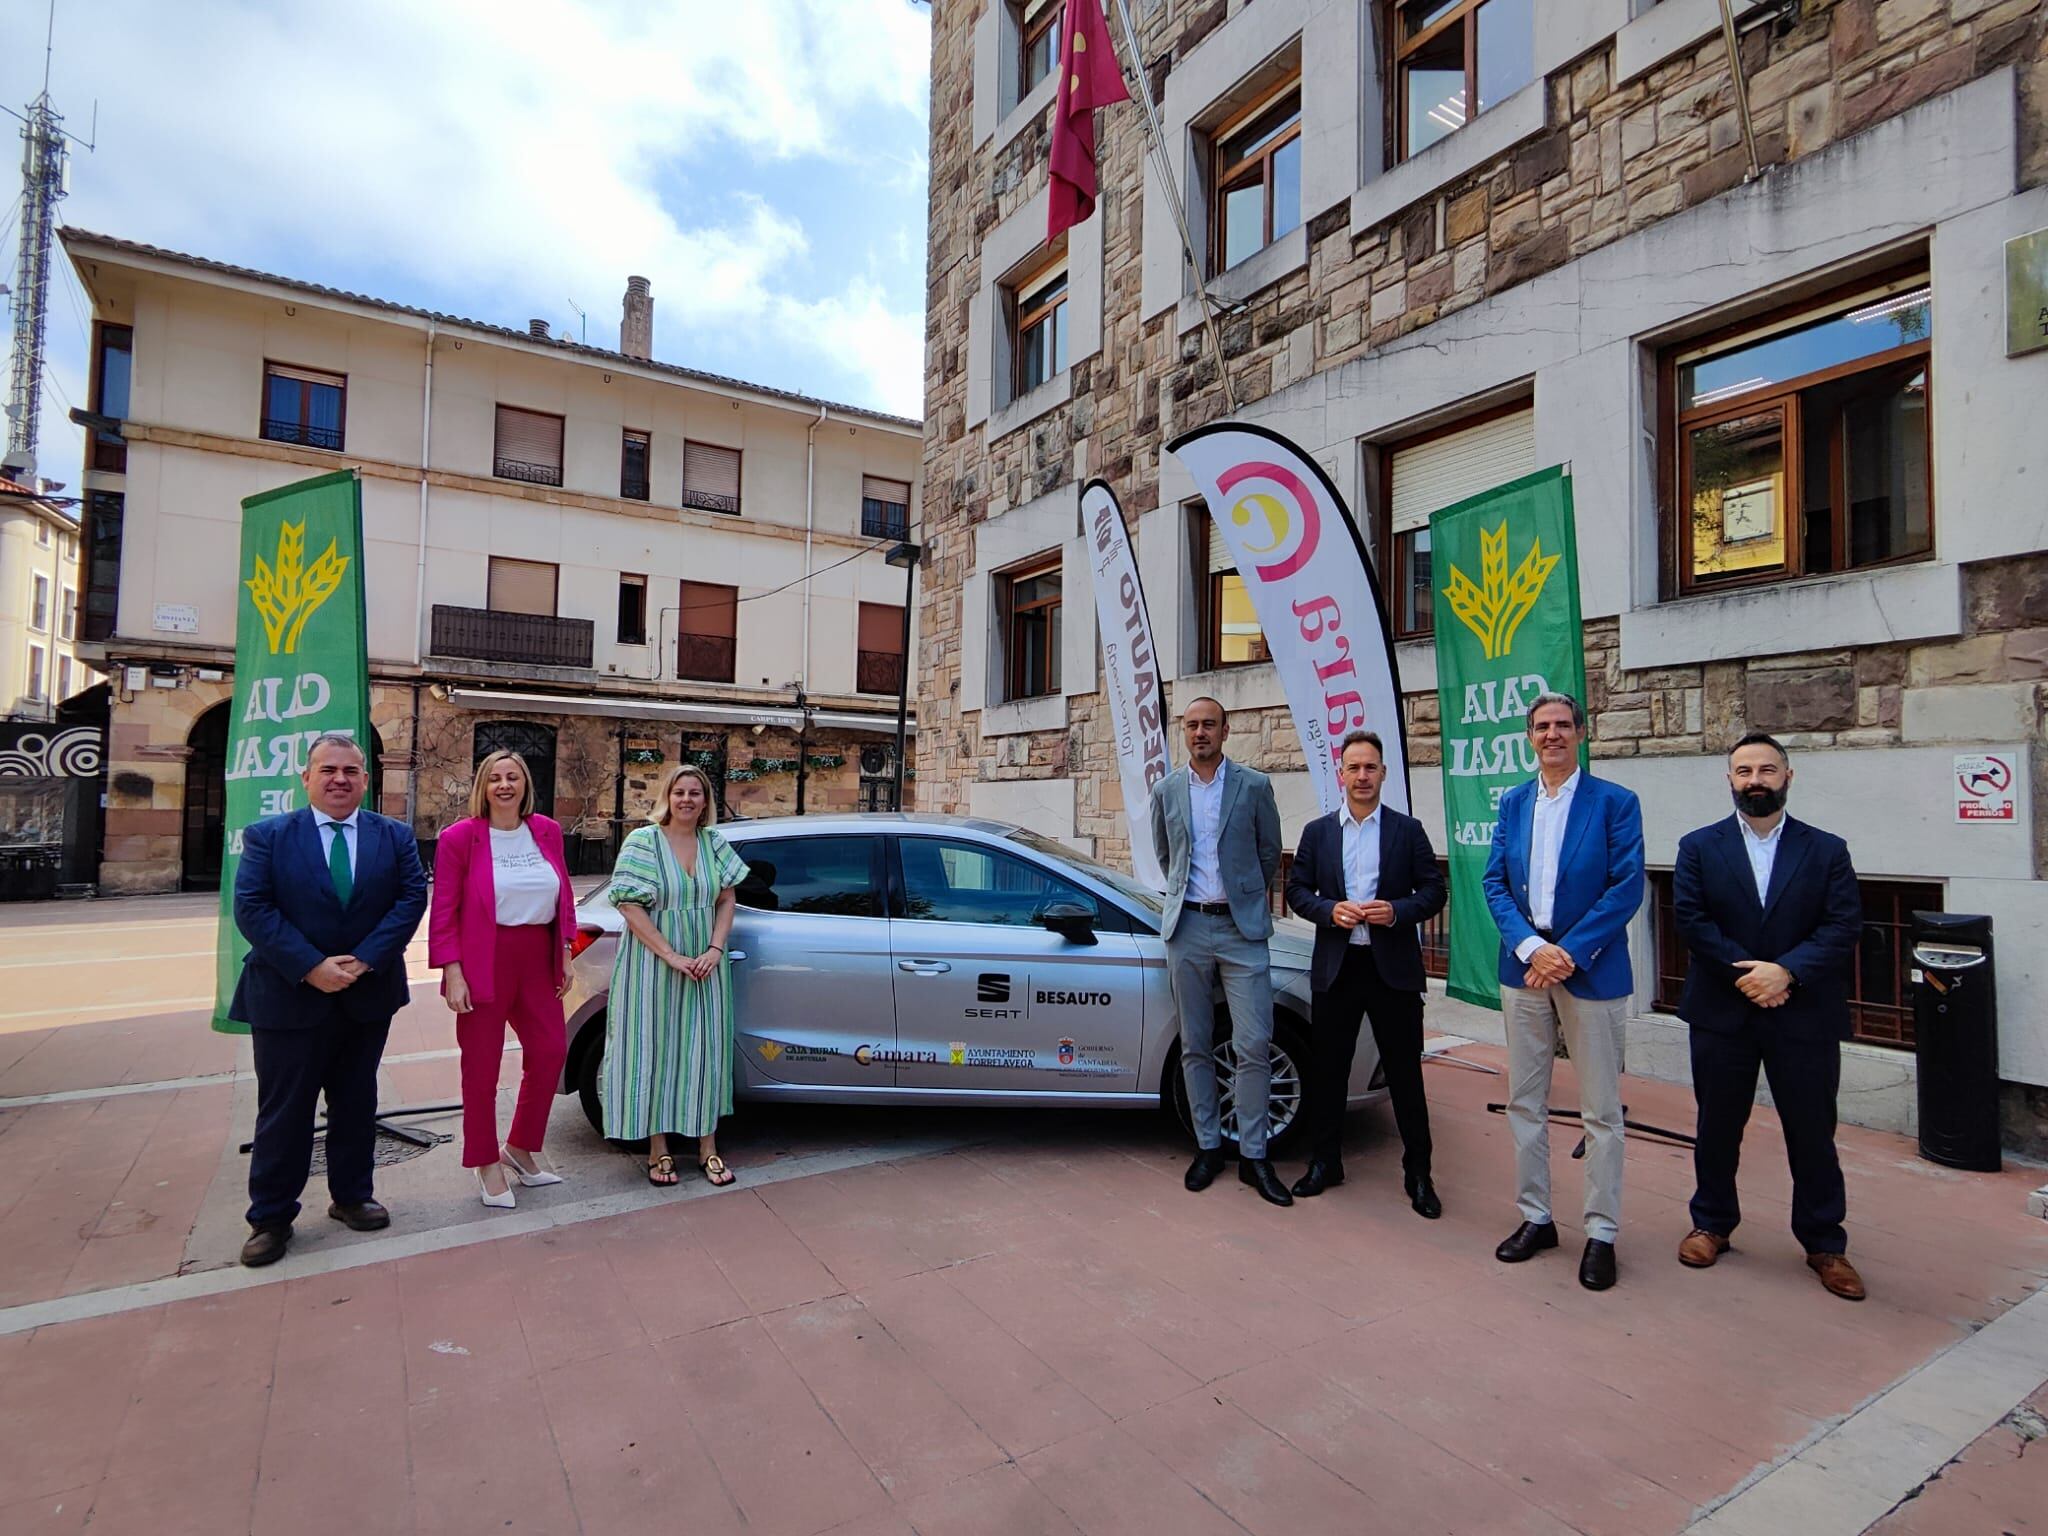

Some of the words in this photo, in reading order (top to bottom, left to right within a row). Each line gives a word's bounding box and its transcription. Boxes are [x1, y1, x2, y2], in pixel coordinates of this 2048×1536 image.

[1967, 809, 2005, 817] PERROS
[1036, 991, 1112, 1006] BESAUTO
[964, 1008, 1022, 1019] SEAT
[785, 1045, 808, 1055] CAJA
[809, 1047, 840, 1056] RURAL
[854, 1043, 937, 1066] Cámara
[967, 1049, 1036, 1059] AYUNTAMIENTO
[968, 1057, 1034, 1068] TORRELAVEGA
